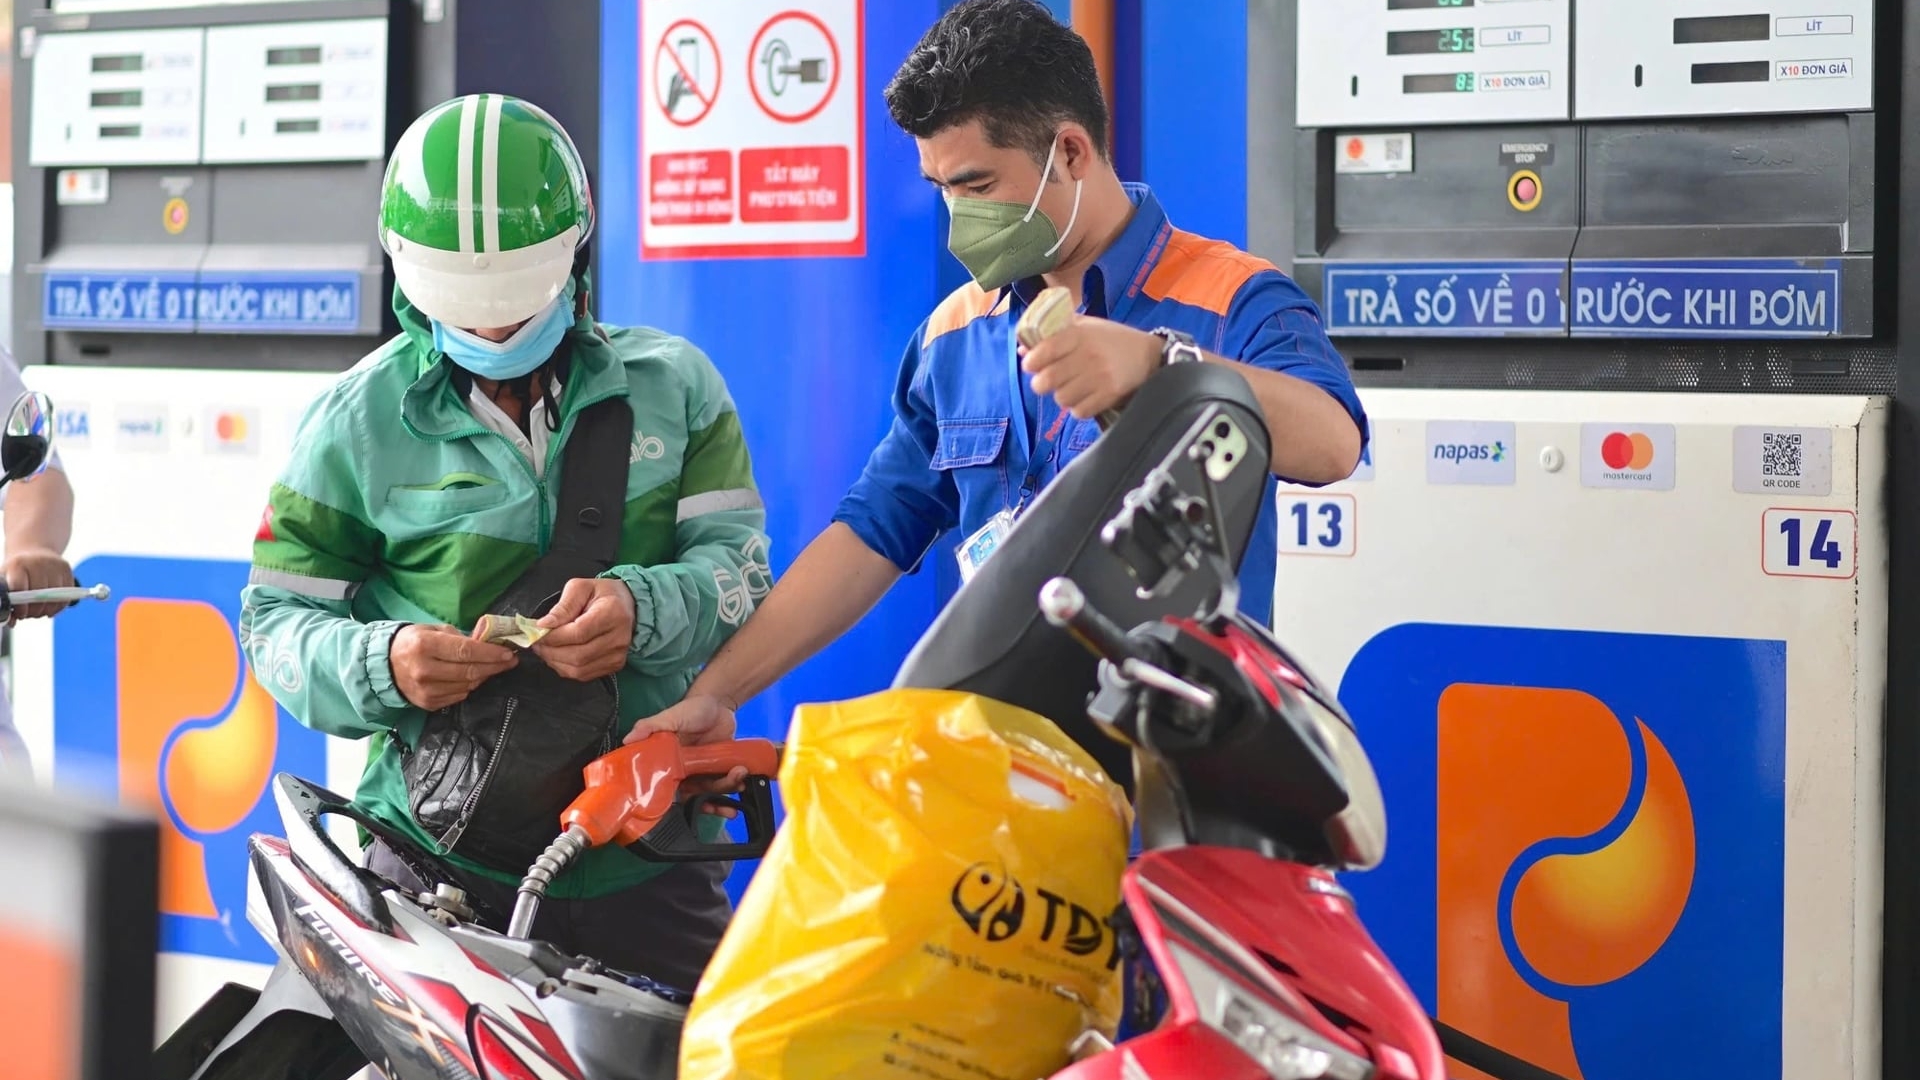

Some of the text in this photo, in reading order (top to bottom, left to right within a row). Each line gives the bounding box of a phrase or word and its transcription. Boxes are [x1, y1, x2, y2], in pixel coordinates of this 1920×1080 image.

[1514, 153, 1536, 163] STOP
[262, 288, 298, 319] KHI
[1344, 274, 1403, 324] TRẢ
[1414, 274, 1459, 325] SỐ
[1468, 272, 1513, 324] VỀ
[1526, 287, 1546, 324] 0
[1683, 288, 1736, 326] KHI
[1750, 284, 1826, 327] BƠM
[57, 411, 89, 436] ISA
[1434, 444, 1489, 465] napas
[1603, 471, 1652, 481] mastercard
[1763, 479, 1801, 489] QR CODE
[1291, 502, 1342, 548] 13
[1780, 518, 1842, 569] 14
[294, 900, 404, 1006] FUTURE
